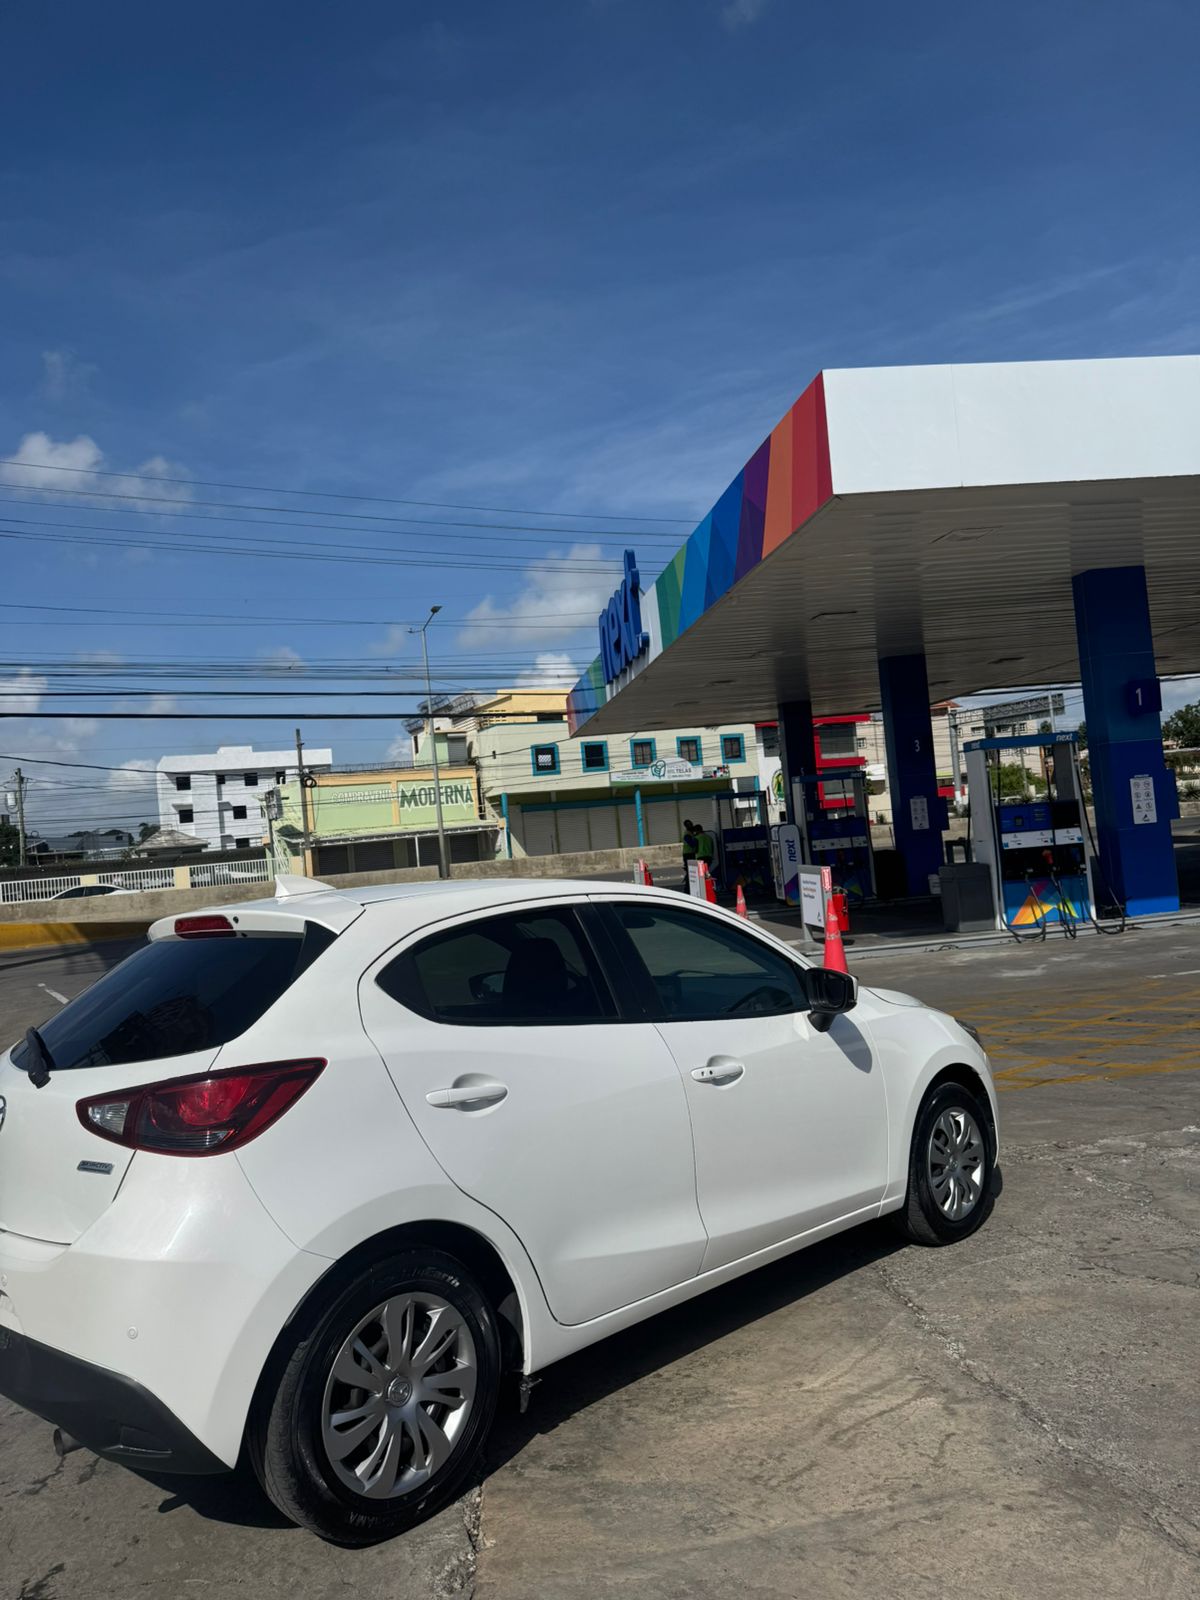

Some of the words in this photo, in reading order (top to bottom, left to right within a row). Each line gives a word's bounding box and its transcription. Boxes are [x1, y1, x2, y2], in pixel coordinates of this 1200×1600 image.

[599, 549, 650, 684] next
[1135, 688, 1142, 706] 1
[914, 739, 920, 753] 3
[1056, 734, 1073, 742] next
[399, 783, 474, 811] MODERNA
[785, 839, 797, 862] next
